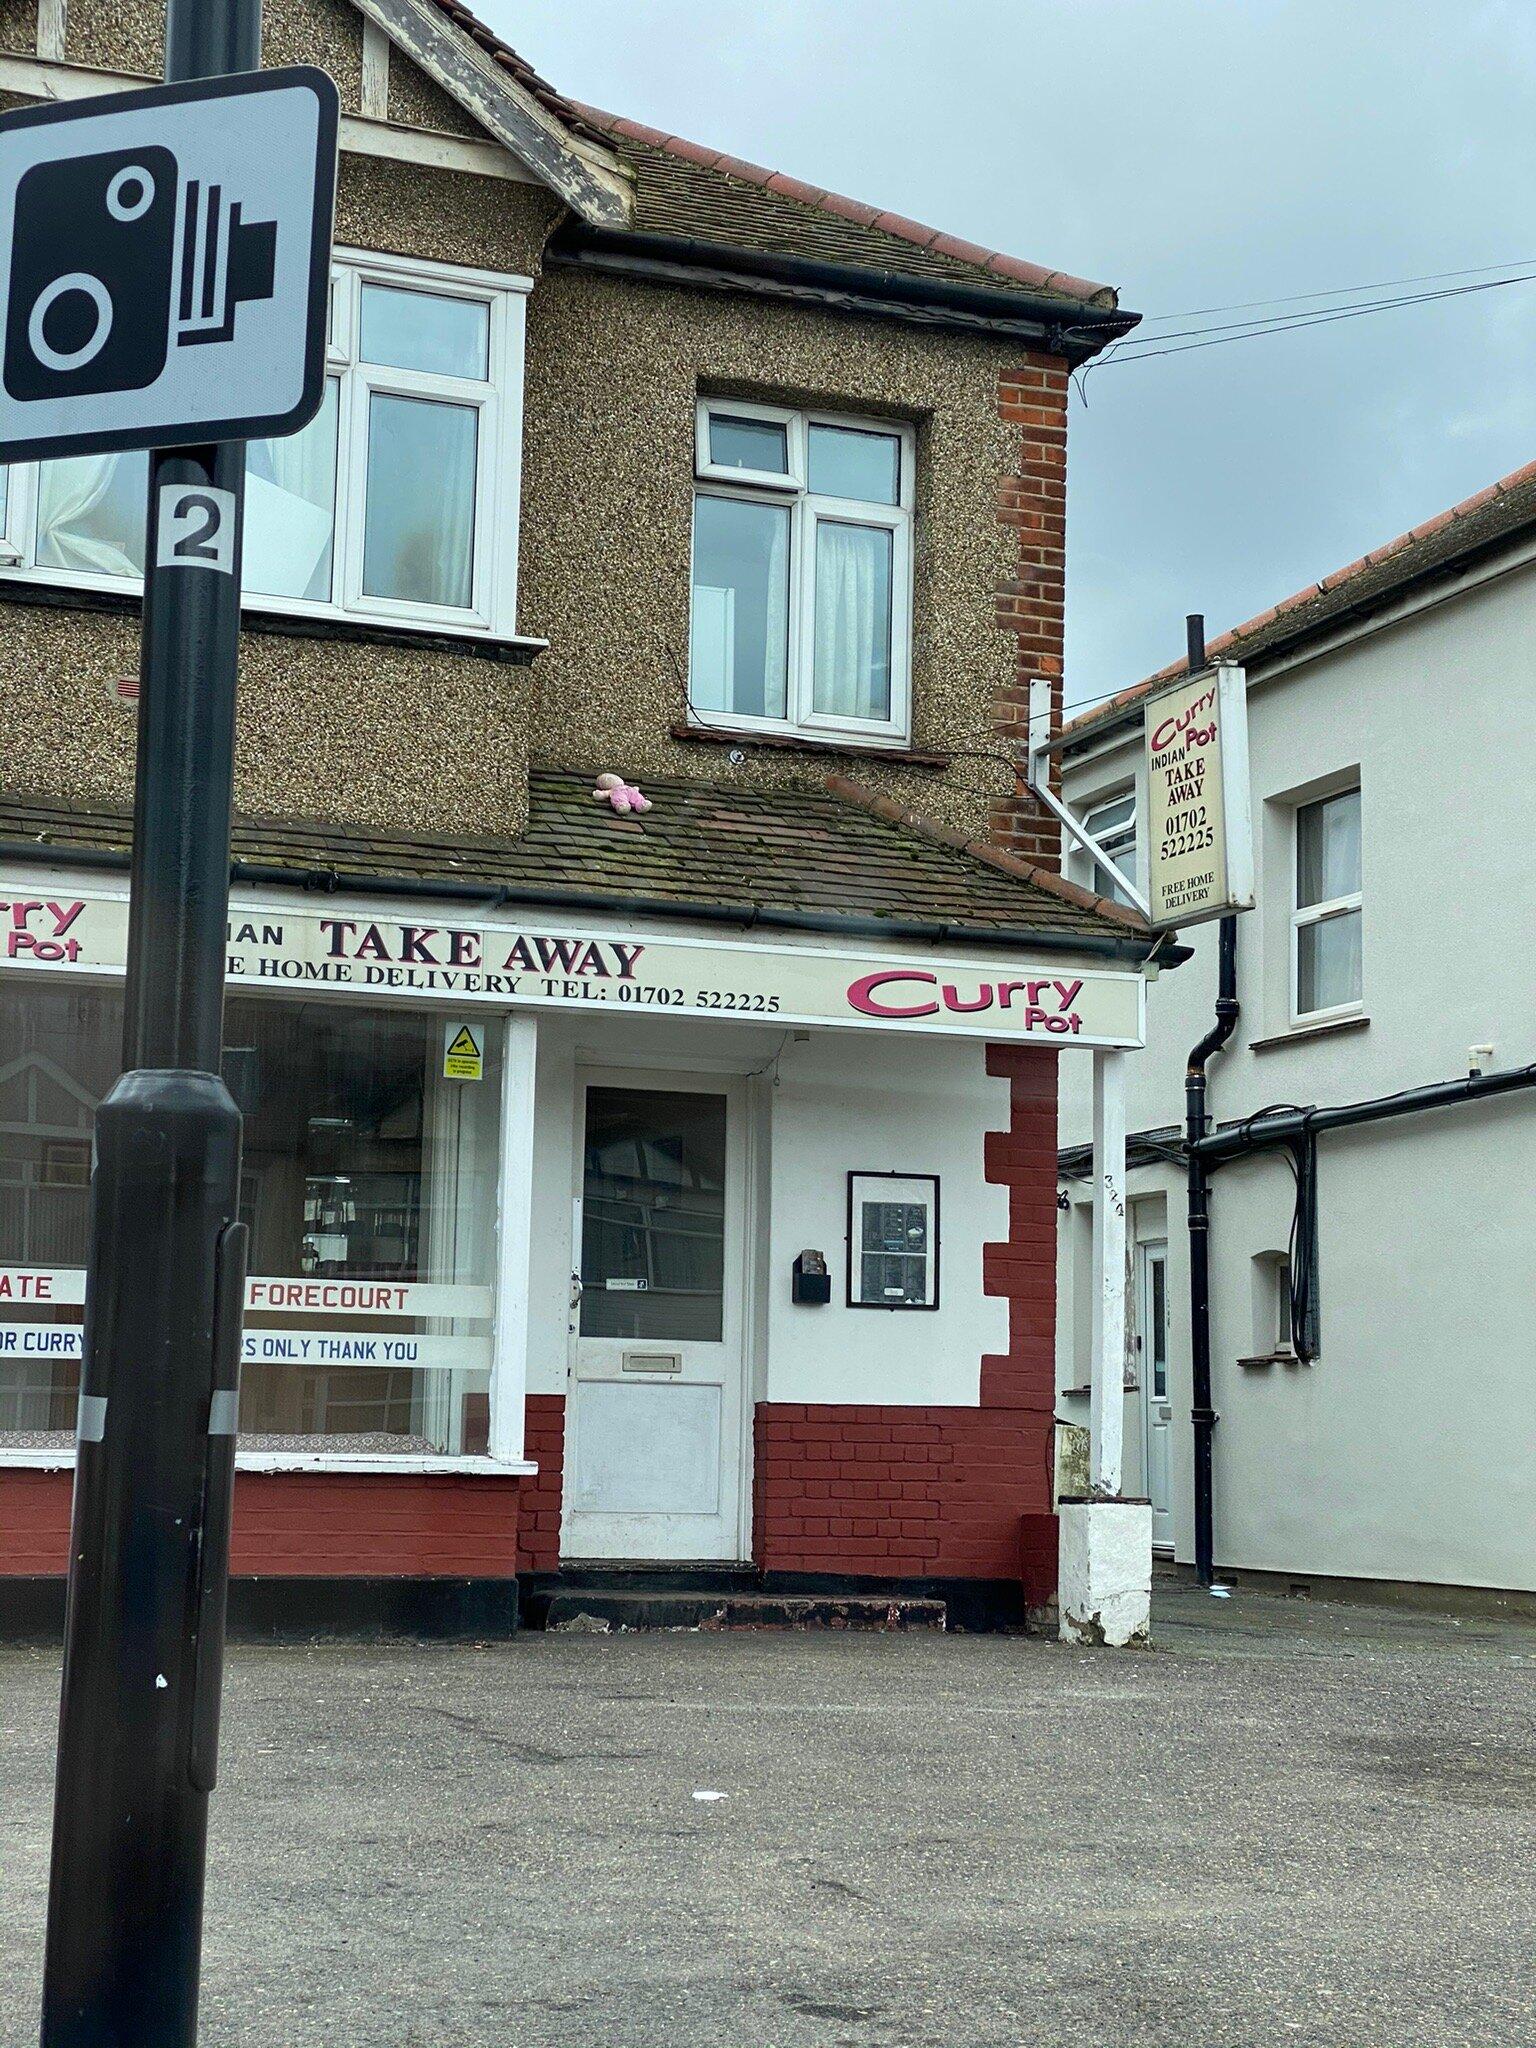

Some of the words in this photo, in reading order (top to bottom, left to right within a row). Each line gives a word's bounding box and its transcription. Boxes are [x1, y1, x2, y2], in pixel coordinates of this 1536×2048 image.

[174, 495, 220, 560] 2
[1151, 687, 1216, 752] Curry
[1185, 722, 1218, 752] Pot
[1152, 747, 1186, 771] INDIAN
[1164, 757, 1206, 787] TAKE
[1167, 778, 1204, 807] AWAY
[1166, 806, 1207, 836] 01702
[1160, 827, 1214, 861] 522225
[1161, 880, 1186, 897] FREE
[1187, 872, 1215, 891] HOME
[1165, 887, 1210, 910] DELIVERY
[8, 931, 82, 962] Pot
[320, 920, 482, 968] TAKE
[502, 935, 646, 980] AWAY
[258, 958, 353, 982] HOME
[365, 966, 522, 994] DELIVERY
[541, 978, 607, 1001] TEL:
[618, 984, 685, 1006] 01702
[695, 991, 780, 1013] 522225
[846, 970, 1083, 1018] Curry
[1025, 1007, 1083, 1034] Pot
[250, 1284, 410, 1309] FORECOURT
[263, 1338, 311, 1357] ONLY
[318, 1340, 377, 1360] THANK
[384, 1341, 418, 1361] YOU
